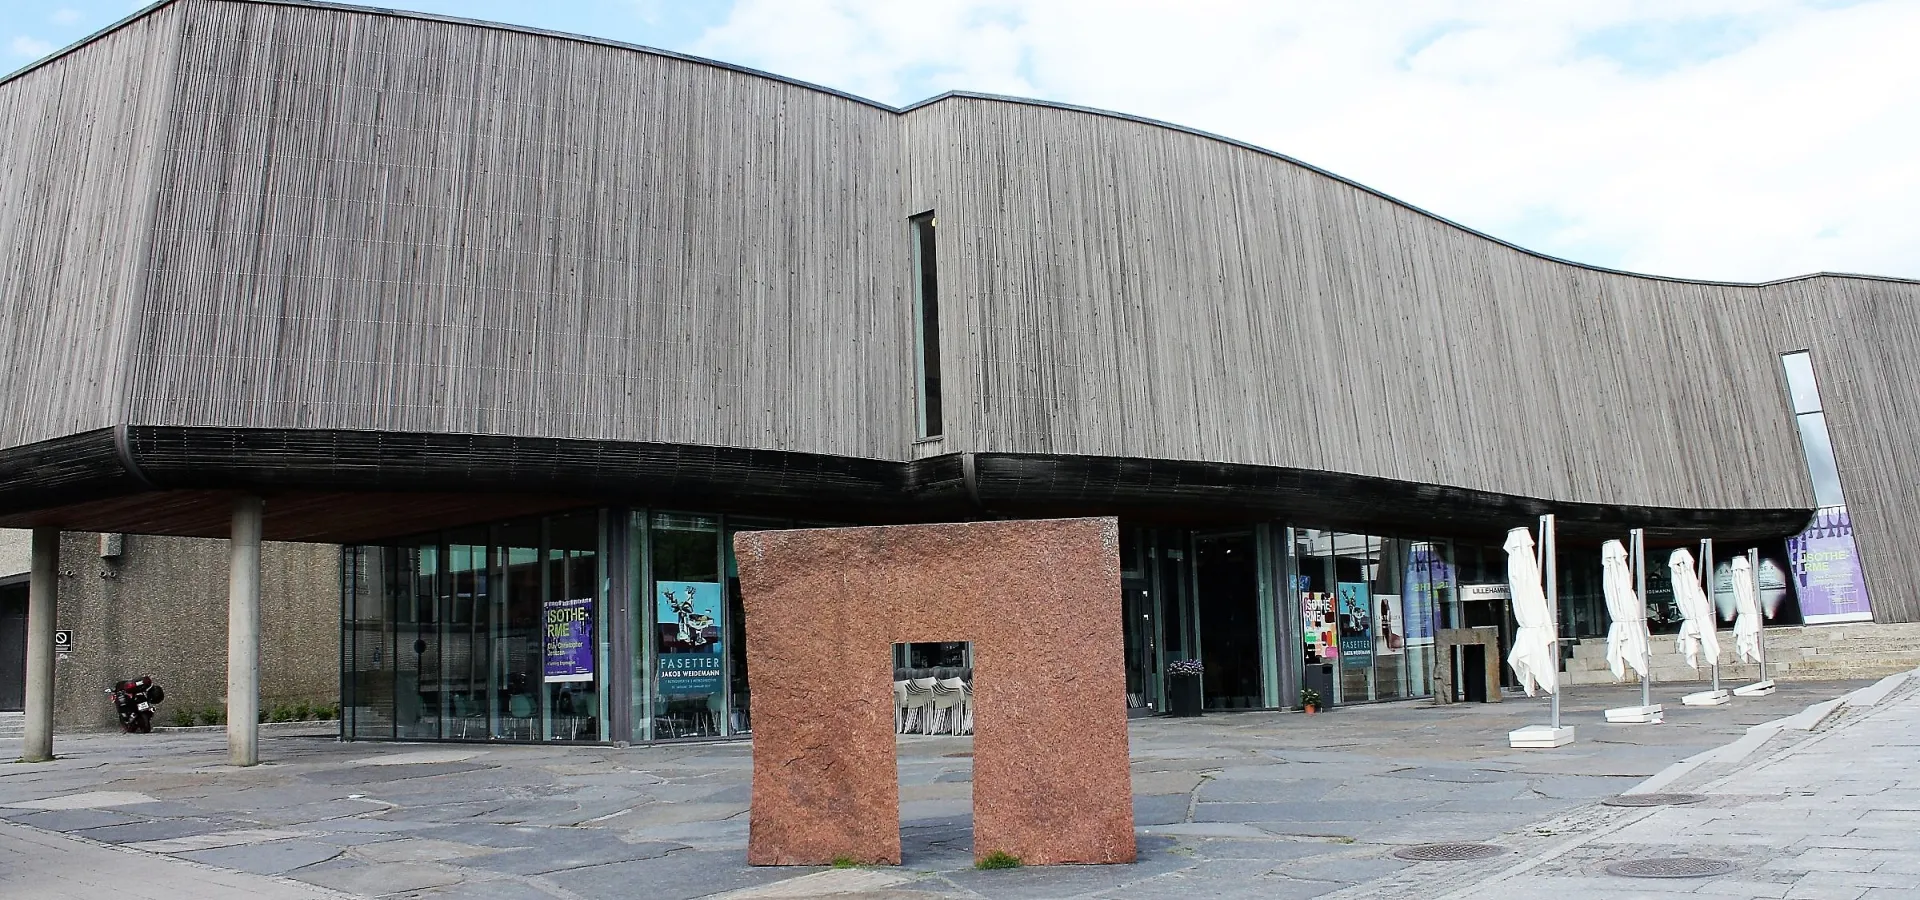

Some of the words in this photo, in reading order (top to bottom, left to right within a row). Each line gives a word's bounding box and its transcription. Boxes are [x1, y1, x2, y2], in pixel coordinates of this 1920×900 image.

[1804, 561, 1829, 572] RME
[547, 606, 589, 623] ISOTHE-
[1305, 611, 1322, 622] RME
[547, 622, 570, 638] RME
[1342, 640, 1370, 649] FASETTER
[660, 657, 720, 669] FASETTER
[661, 670, 681, 678] JAKOB
[682, 669, 720, 677] WEIDEMANN
